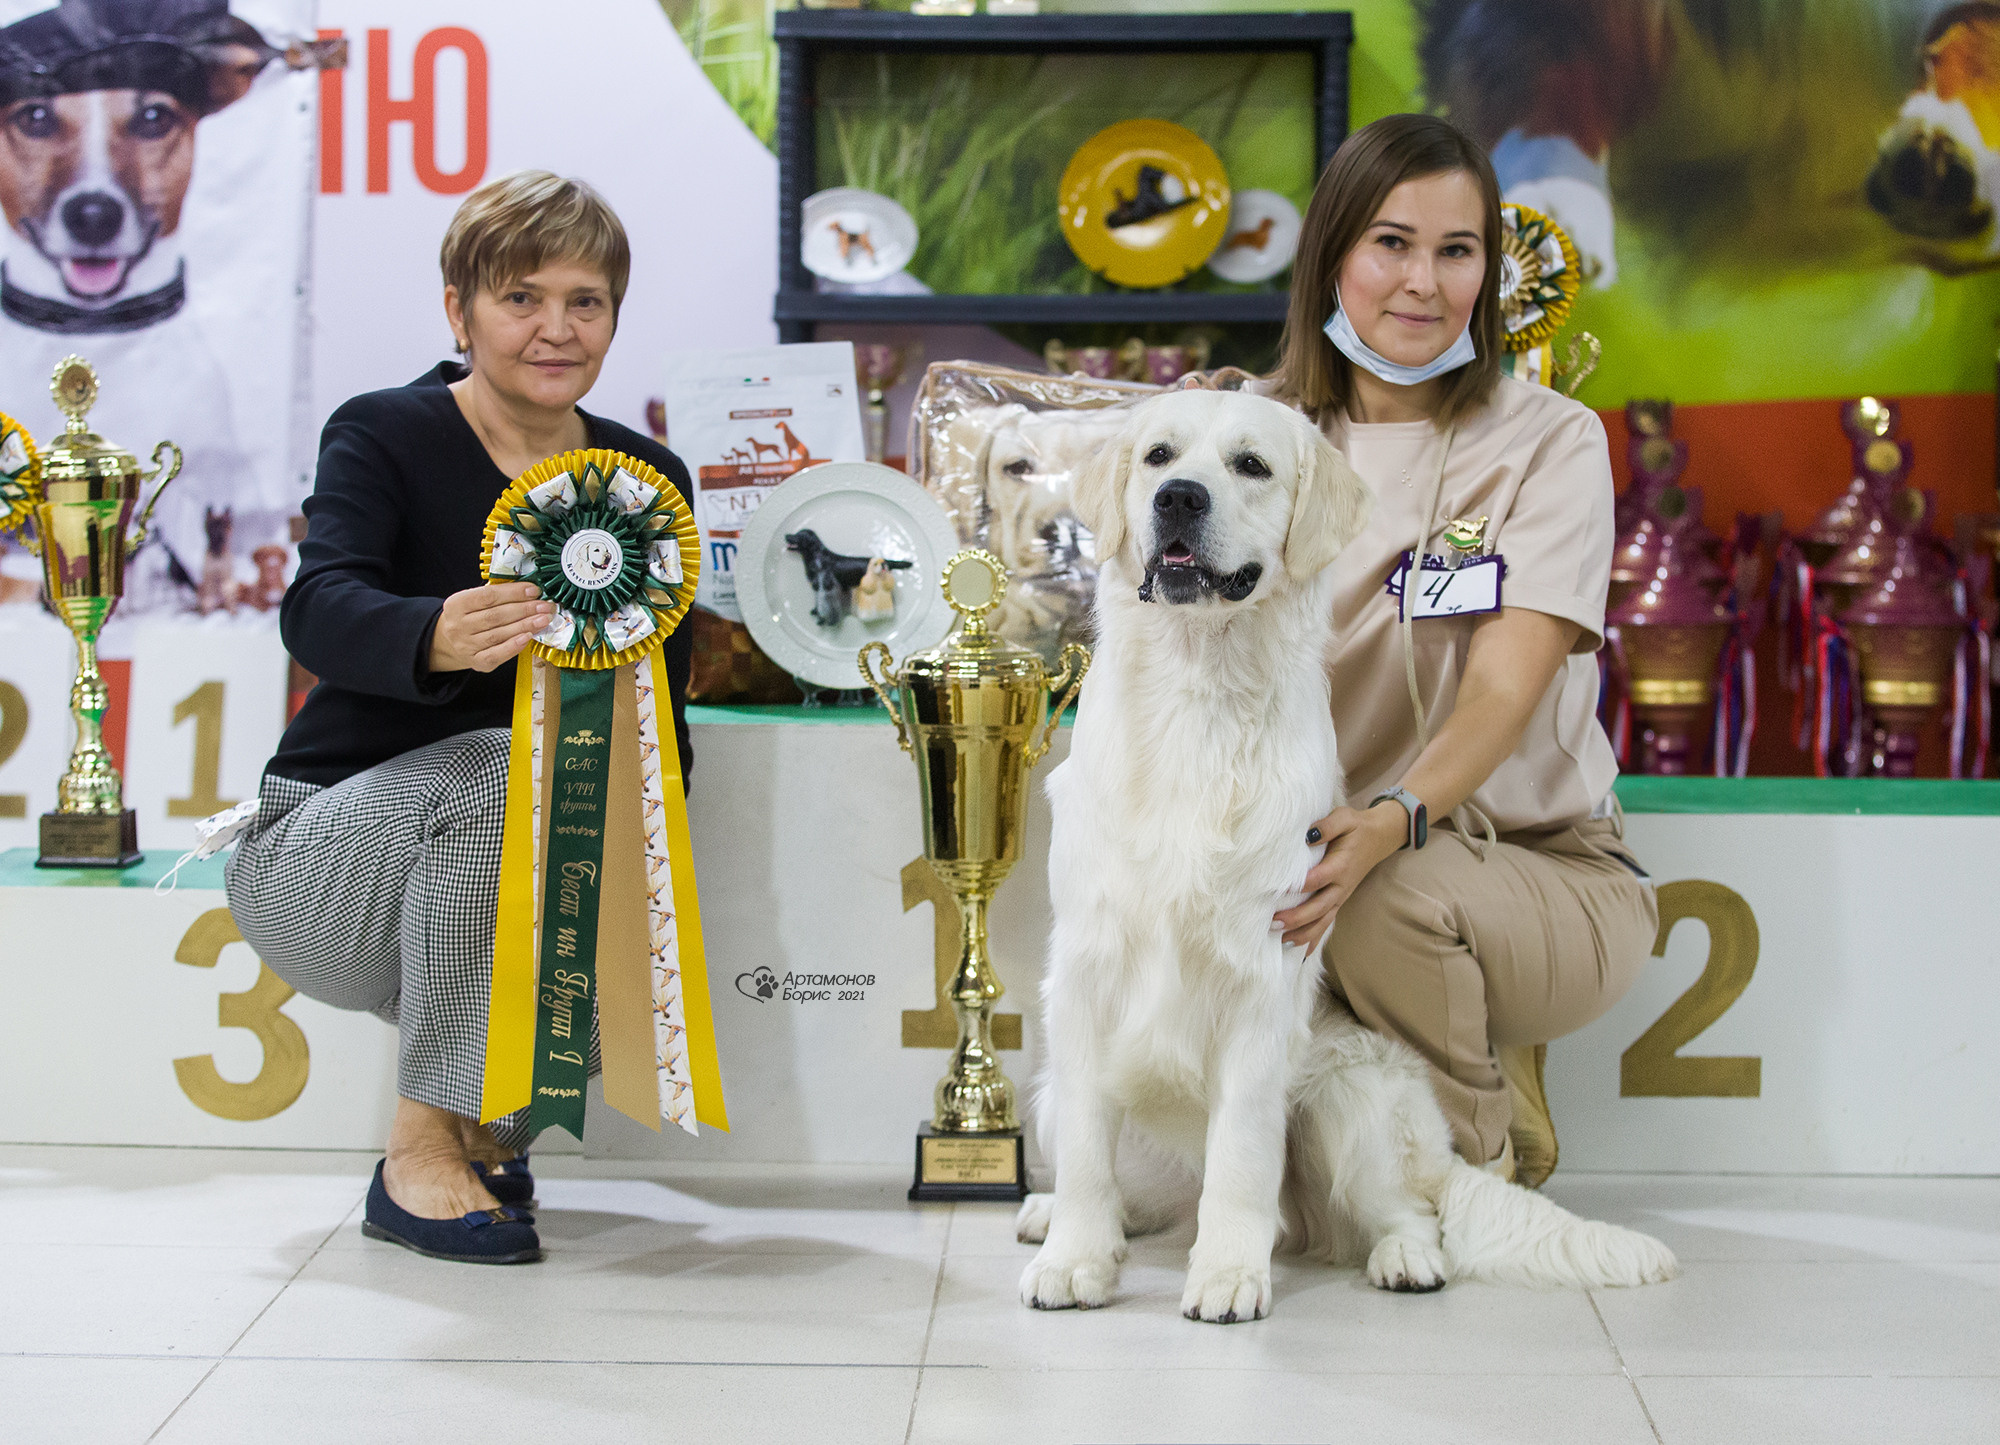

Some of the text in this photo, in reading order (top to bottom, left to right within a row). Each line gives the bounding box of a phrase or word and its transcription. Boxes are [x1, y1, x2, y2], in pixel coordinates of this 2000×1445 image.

[567, 563, 586, 584] KENNEL
[1423, 573, 1455, 608] 4
[166, 681, 242, 818] 1
[556, 927, 578, 958] ин
[901, 854, 1023, 1050] 1
[1620, 879, 1762, 1098] 2
[172, 907, 310, 1122] 3
